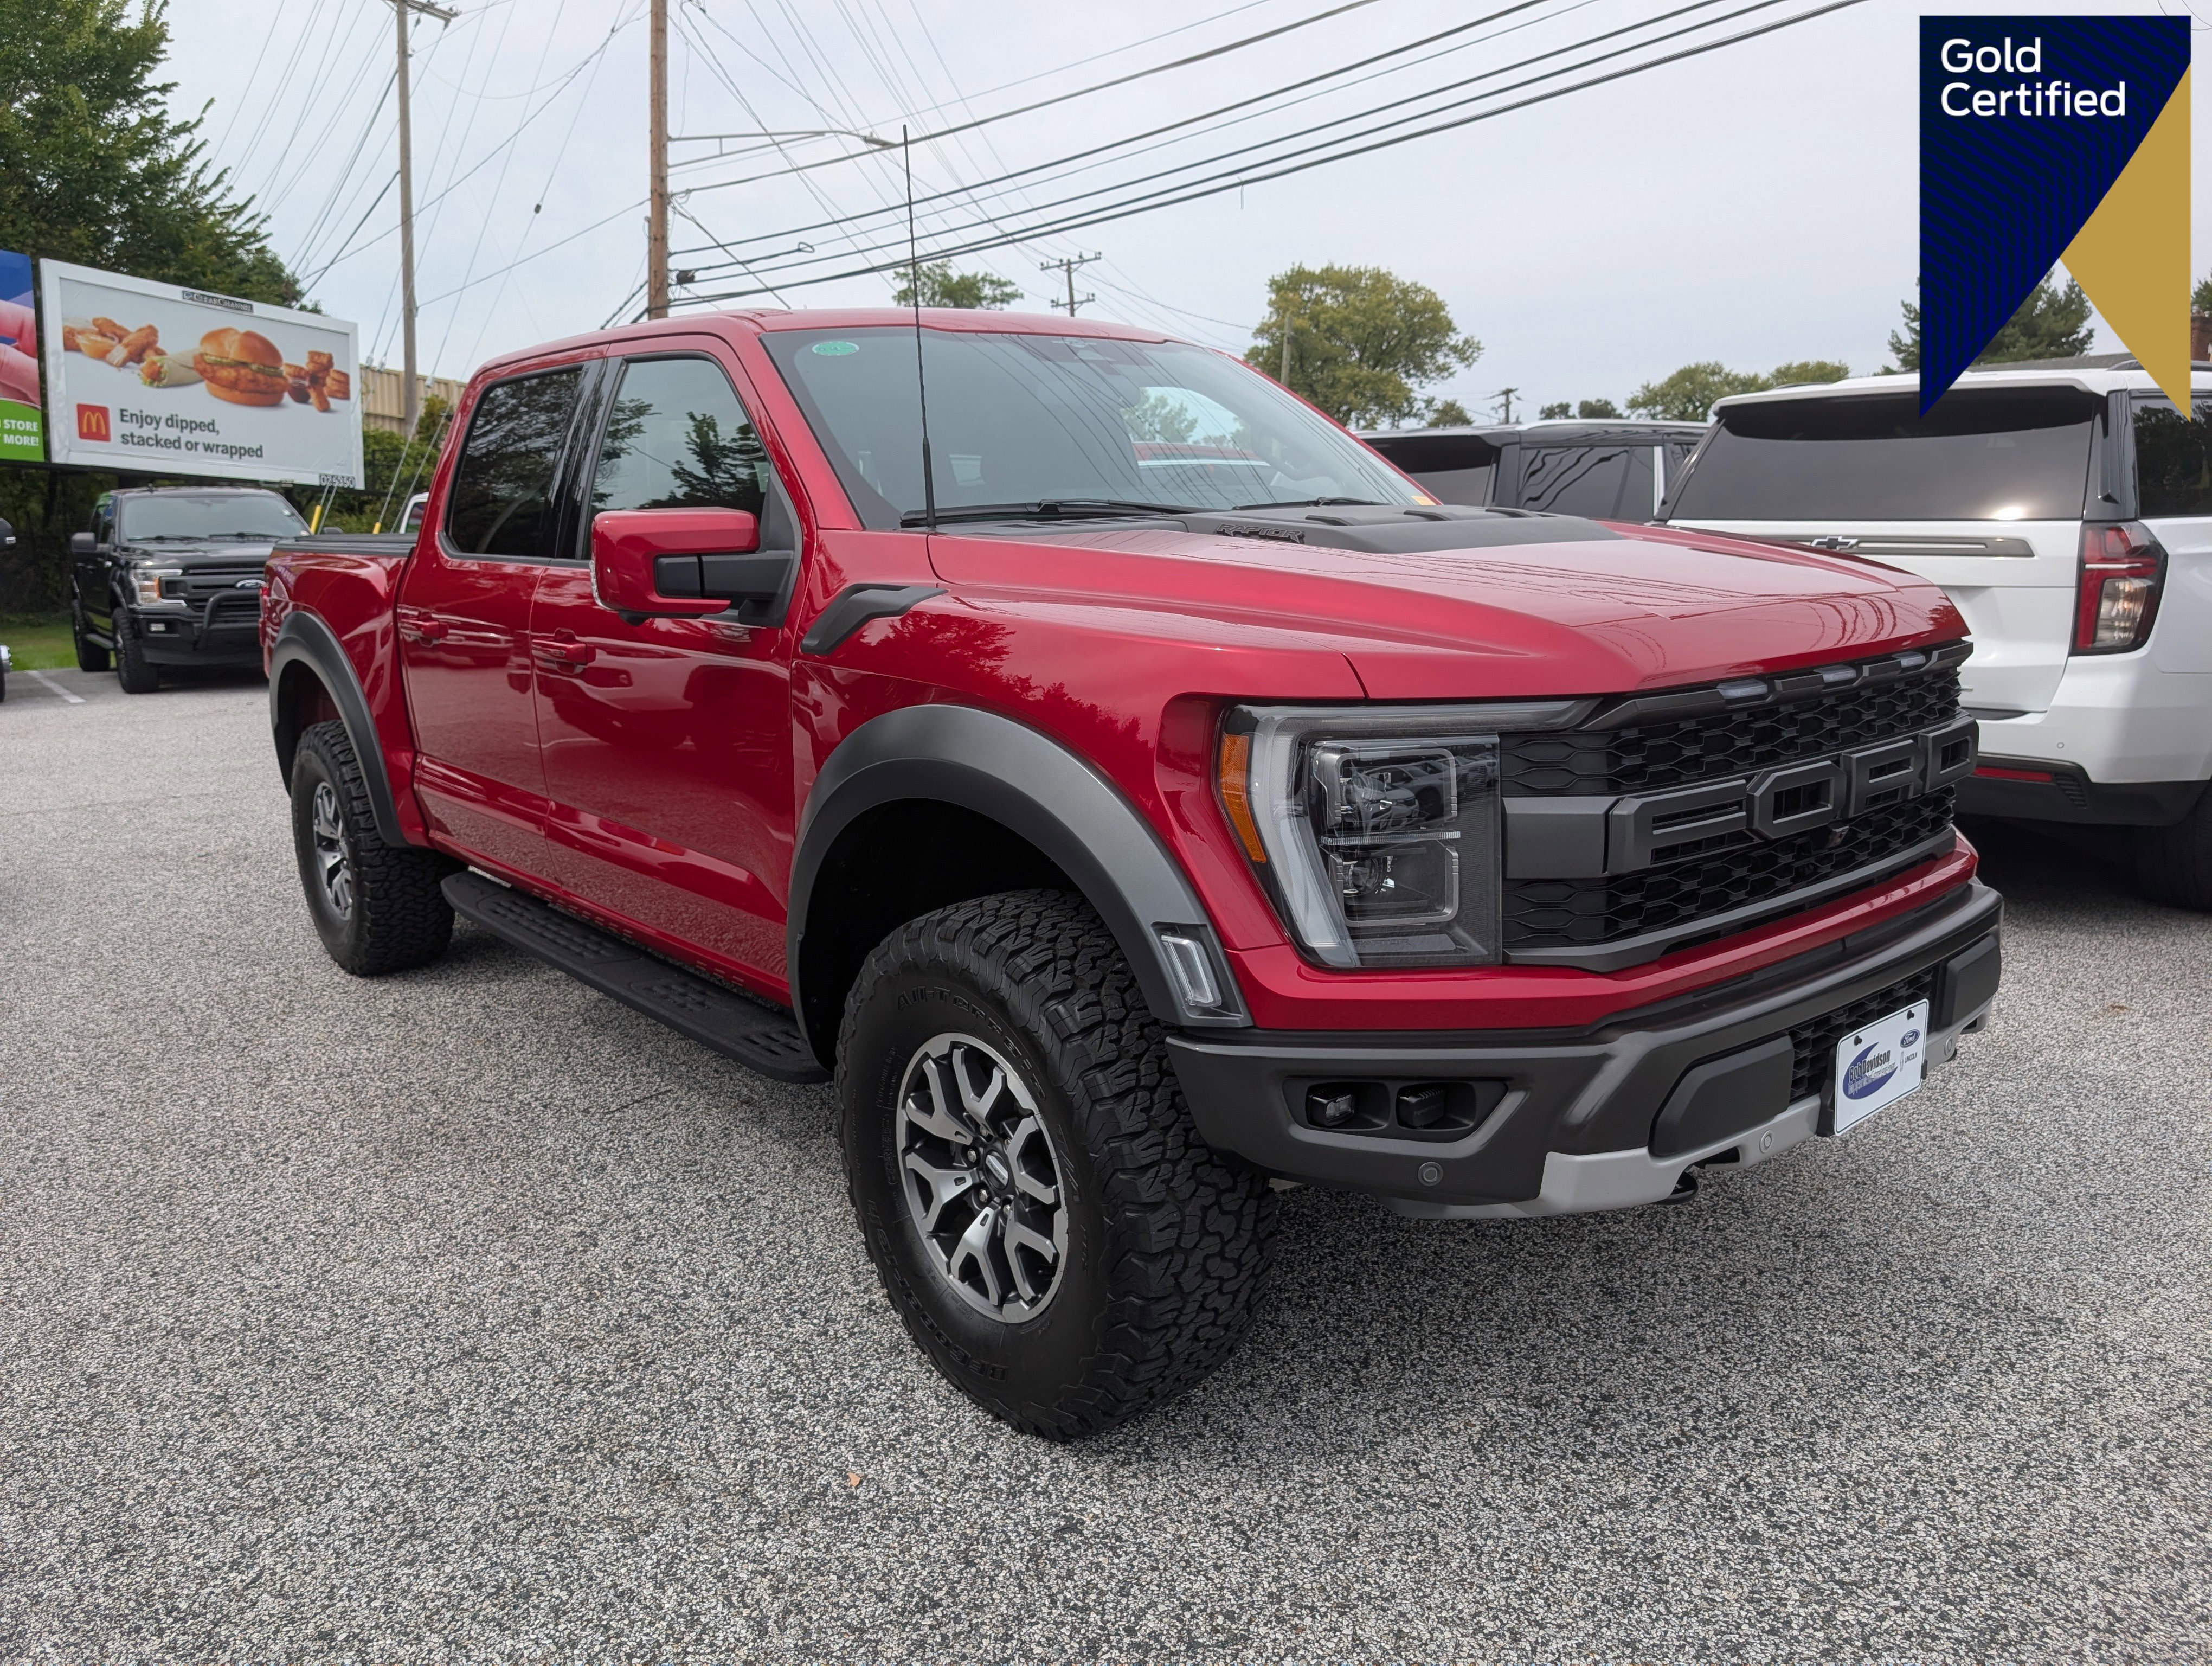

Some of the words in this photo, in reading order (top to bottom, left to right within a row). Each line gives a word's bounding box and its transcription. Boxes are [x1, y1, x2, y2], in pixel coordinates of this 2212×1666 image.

[3, 419, 38, 432] STORE
[120, 408, 162, 431] Enjoy
[165, 414, 220, 435] dipped,
[4, 434, 39, 447] MORE!
[121, 432, 181, 450] stacked
[185, 440, 200, 452] or
[202, 444, 263, 460] wrapped
[1217, 524, 1305, 544] RAPTOR
[1607, 710, 1979, 875] FORD
[1849, 1061, 1862, 1083] Bob
[1862, 1049, 1891, 1074] Davidson
